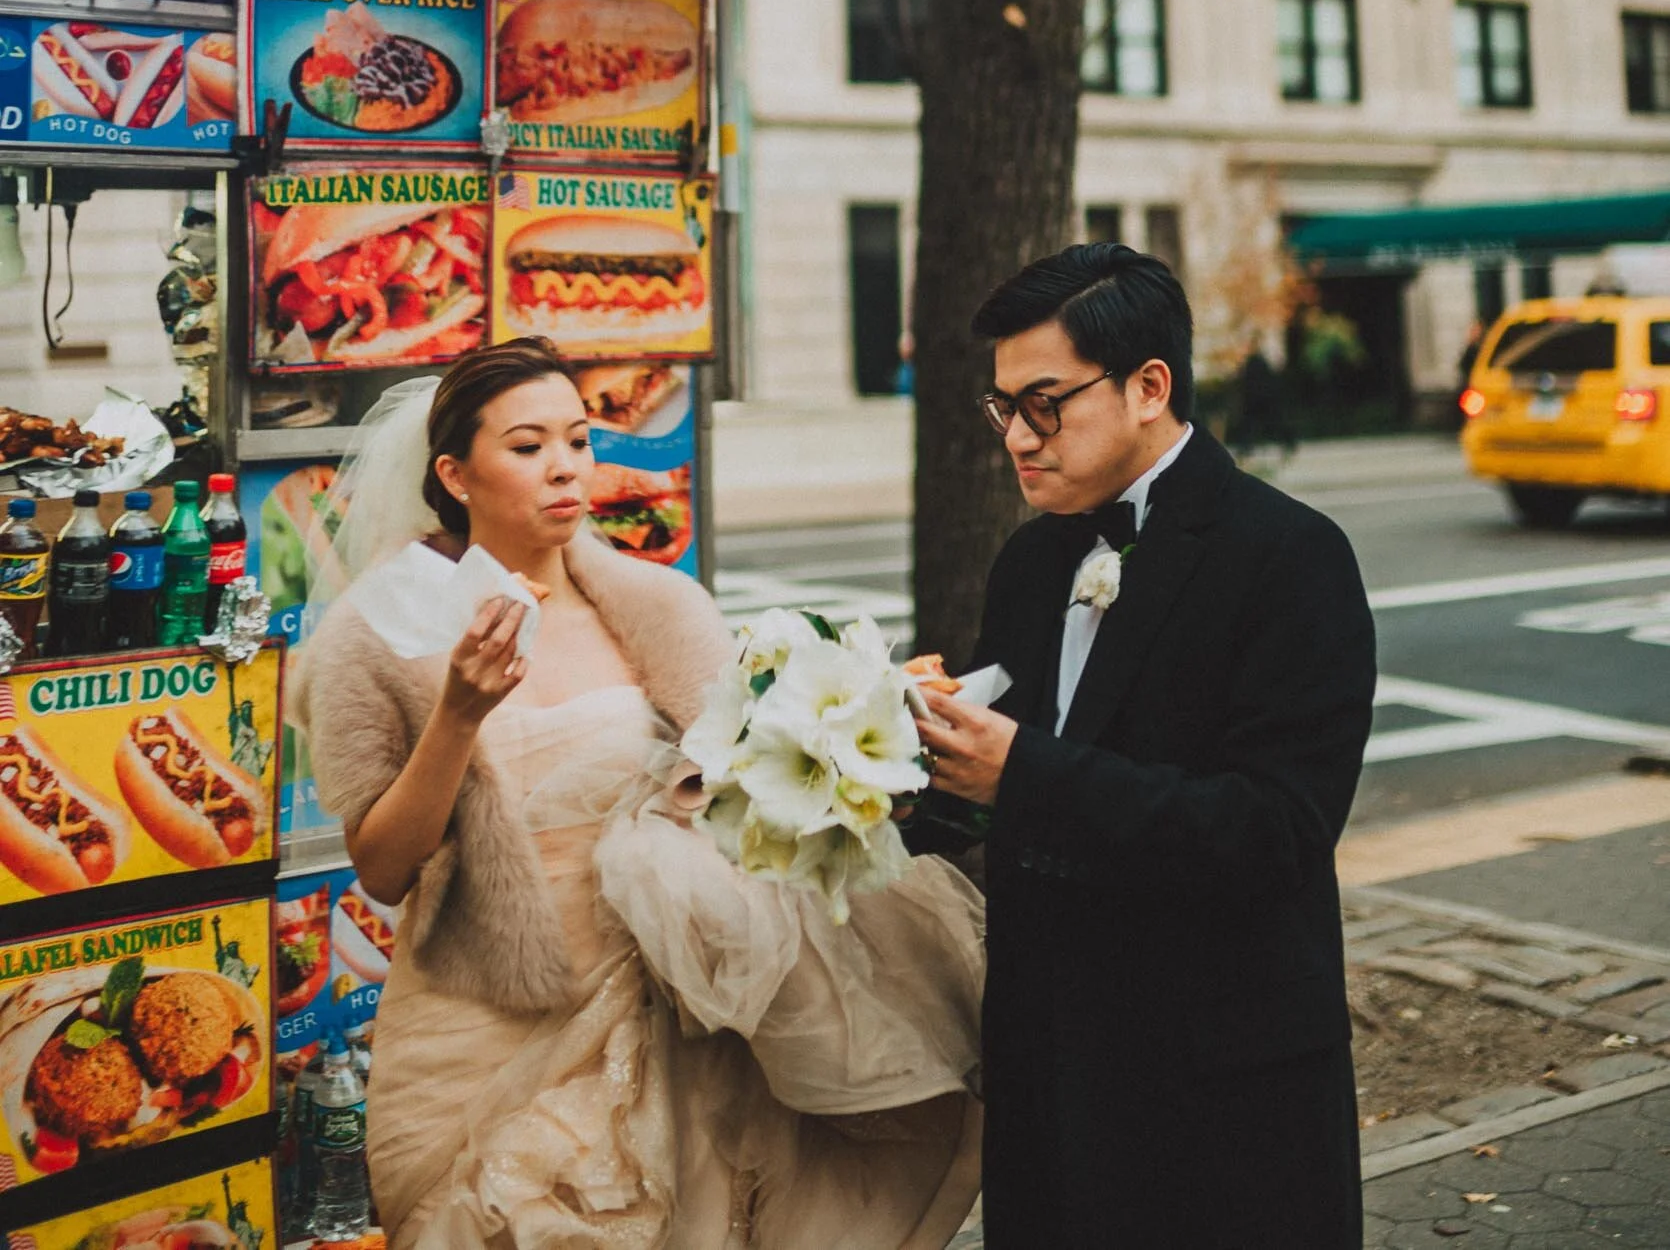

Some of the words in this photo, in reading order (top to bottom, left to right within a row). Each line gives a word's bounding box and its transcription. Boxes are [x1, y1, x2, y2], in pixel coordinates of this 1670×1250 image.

[0, 105, 23, 130] D
[50, 117, 88, 134] HOT
[93, 124, 132, 144] DOG
[193, 123, 230, 141] HOT
[507, 122, 543, 147] PICY
[548, 124, 618, 150] ITALIAN
[268, 174, 375, 204] ITALIAN
[380, 174, 489, 204] SAUSAGE
[537, 177, 581, 207] HOT
[585, 179, 676, 210] SAUSAGE
[30, 670, 133, 714] CHILI
[140, 661, 217, 701] DOG
[0, 941, 76, 980] LAFEL
[82, 916, 204, 965] SANDWICH
[350, 988, 380, 1009] HO
